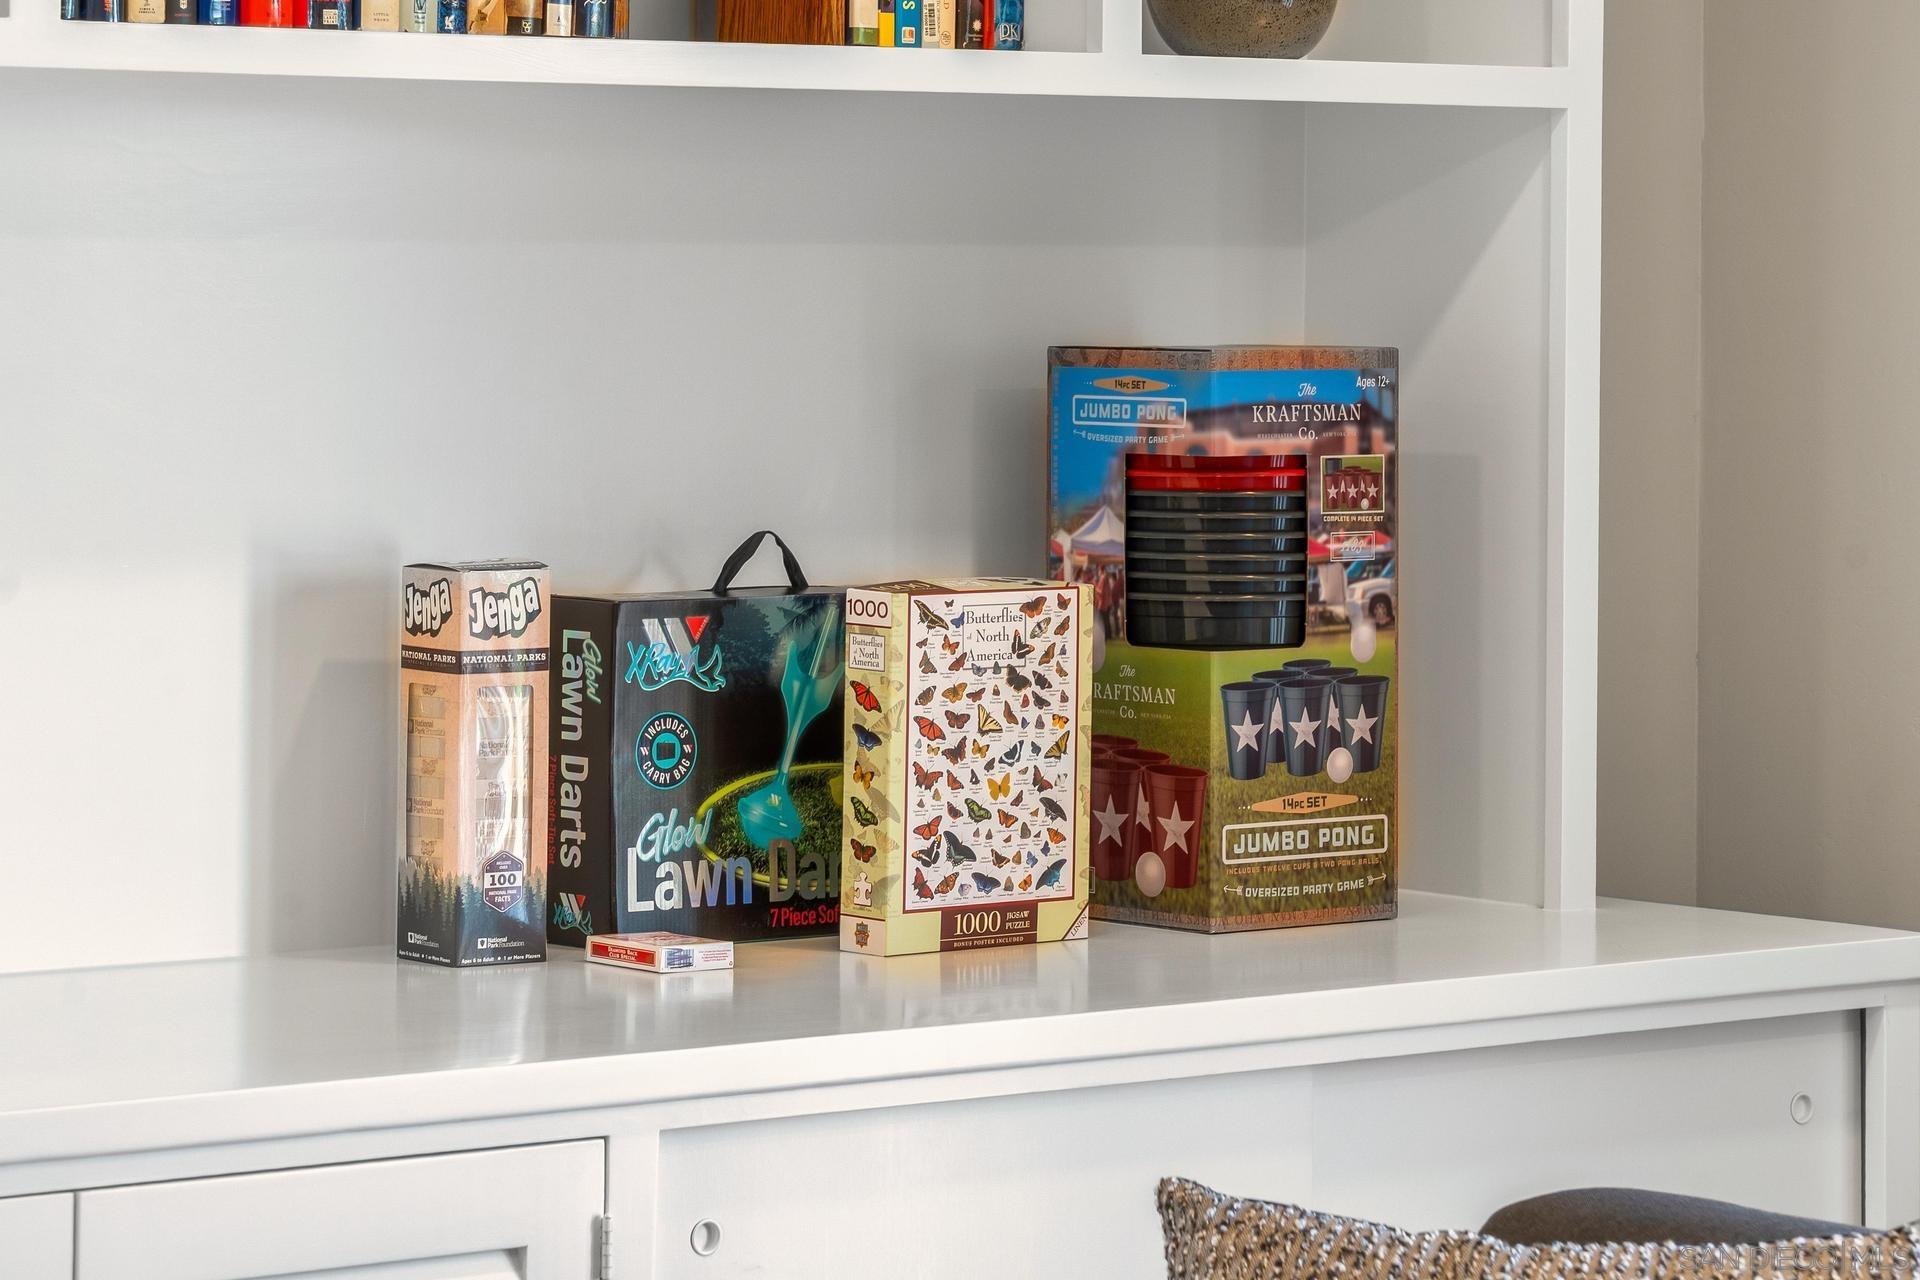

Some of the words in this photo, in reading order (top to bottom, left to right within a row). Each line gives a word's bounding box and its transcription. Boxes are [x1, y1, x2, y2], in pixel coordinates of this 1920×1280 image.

[1002, 23, 1018, 38] DK
[1131, 380, 1146, 390] SET
[1297, 382, 1317, 398] The
[1356, 375, 1376, 390] Ages
[1377, 375, 1390, 388] 12+
[1080, 402, 1130, 420] JUMBO
[1137, 404, 1176, 421] PONG
[1252, 403, 1362, 423] KRAFTSMAN
[1086, 432, 1124, 444] OVERSIZED
[1125, 436, 1147, 444] PARTY
[1148, 436, 1168, 444] GAME
[1298, 427, 1318, 440] Co.
[406, 578, 452, 635] Jenga
[470, 578, 540, 636] Jenga
[847, 598, 888, 619] 1000
[966, 607, 1024, 624] Butterflies
[852, 636, 883, 648] Butterflies
[976, 626, 1009, 642] North
[402, 650, 432, 661] NATIONAL
[433, 654, 456, 664] PARKS
[463, 655, 513, 664] NATIONAL
[516, 652, 546, 661] PARKS
[859, 647, 879, 659] North
[966, 648, 1013, 662] America
[851, 656, 880, 668] America
[582, 638, 602, 704] Glow
[1120, 664, 1136, 678] The
[561, 628, 592, 742] Lawn
[1094, 682, 1175, 704] RAFTSMAN
[1120, 706, 1137, 719] Co.
[644, 718, 688, 740] INCLUDES
[643, 761, 670, 784] CARRY
[673, 758, 691, 780] BAG
[549, 764, 557, 797] Piece
[1307, 796, 1328, 808] SET
[560, 754, 589, 869] Darts
[636, 808, 713, 863] Glow
[1233, 830, 1309, 854] JUMBO
[1319, 825, 1374, 848] PONG
[548, 846, 556, 865] Set
[627, 846, 753, 912] Lawn
[769, 838, 841, 902] Dar
[1226, 865, 1260, 875] INCLUDES
[1263, 863, 1291, 873] TWELVE
[1293, 863, 1311, 871] CUPS
[1337, 859, 1356, 867] PONG
[490, 873, 516, 886] 100
[1245, 885, 1299, 898] OVERSIZED
[1302, 883, 1334, 896] PARTY
[1337, 878, 1364, 892] GAME
[771, 908, 779, 928] 7
[781, 906, 816, 927] Piece
[818, 904, 840, 923] Sof
[953, 910, 1001, 936] 1000
[1006, 910, 1030, 920] JIGSAW
[1005, 921, 1030, 930] PUZZLE
[1070, 914, 1088, 937] LINEN
[996, 936, 1024, 944] INCLUDED
